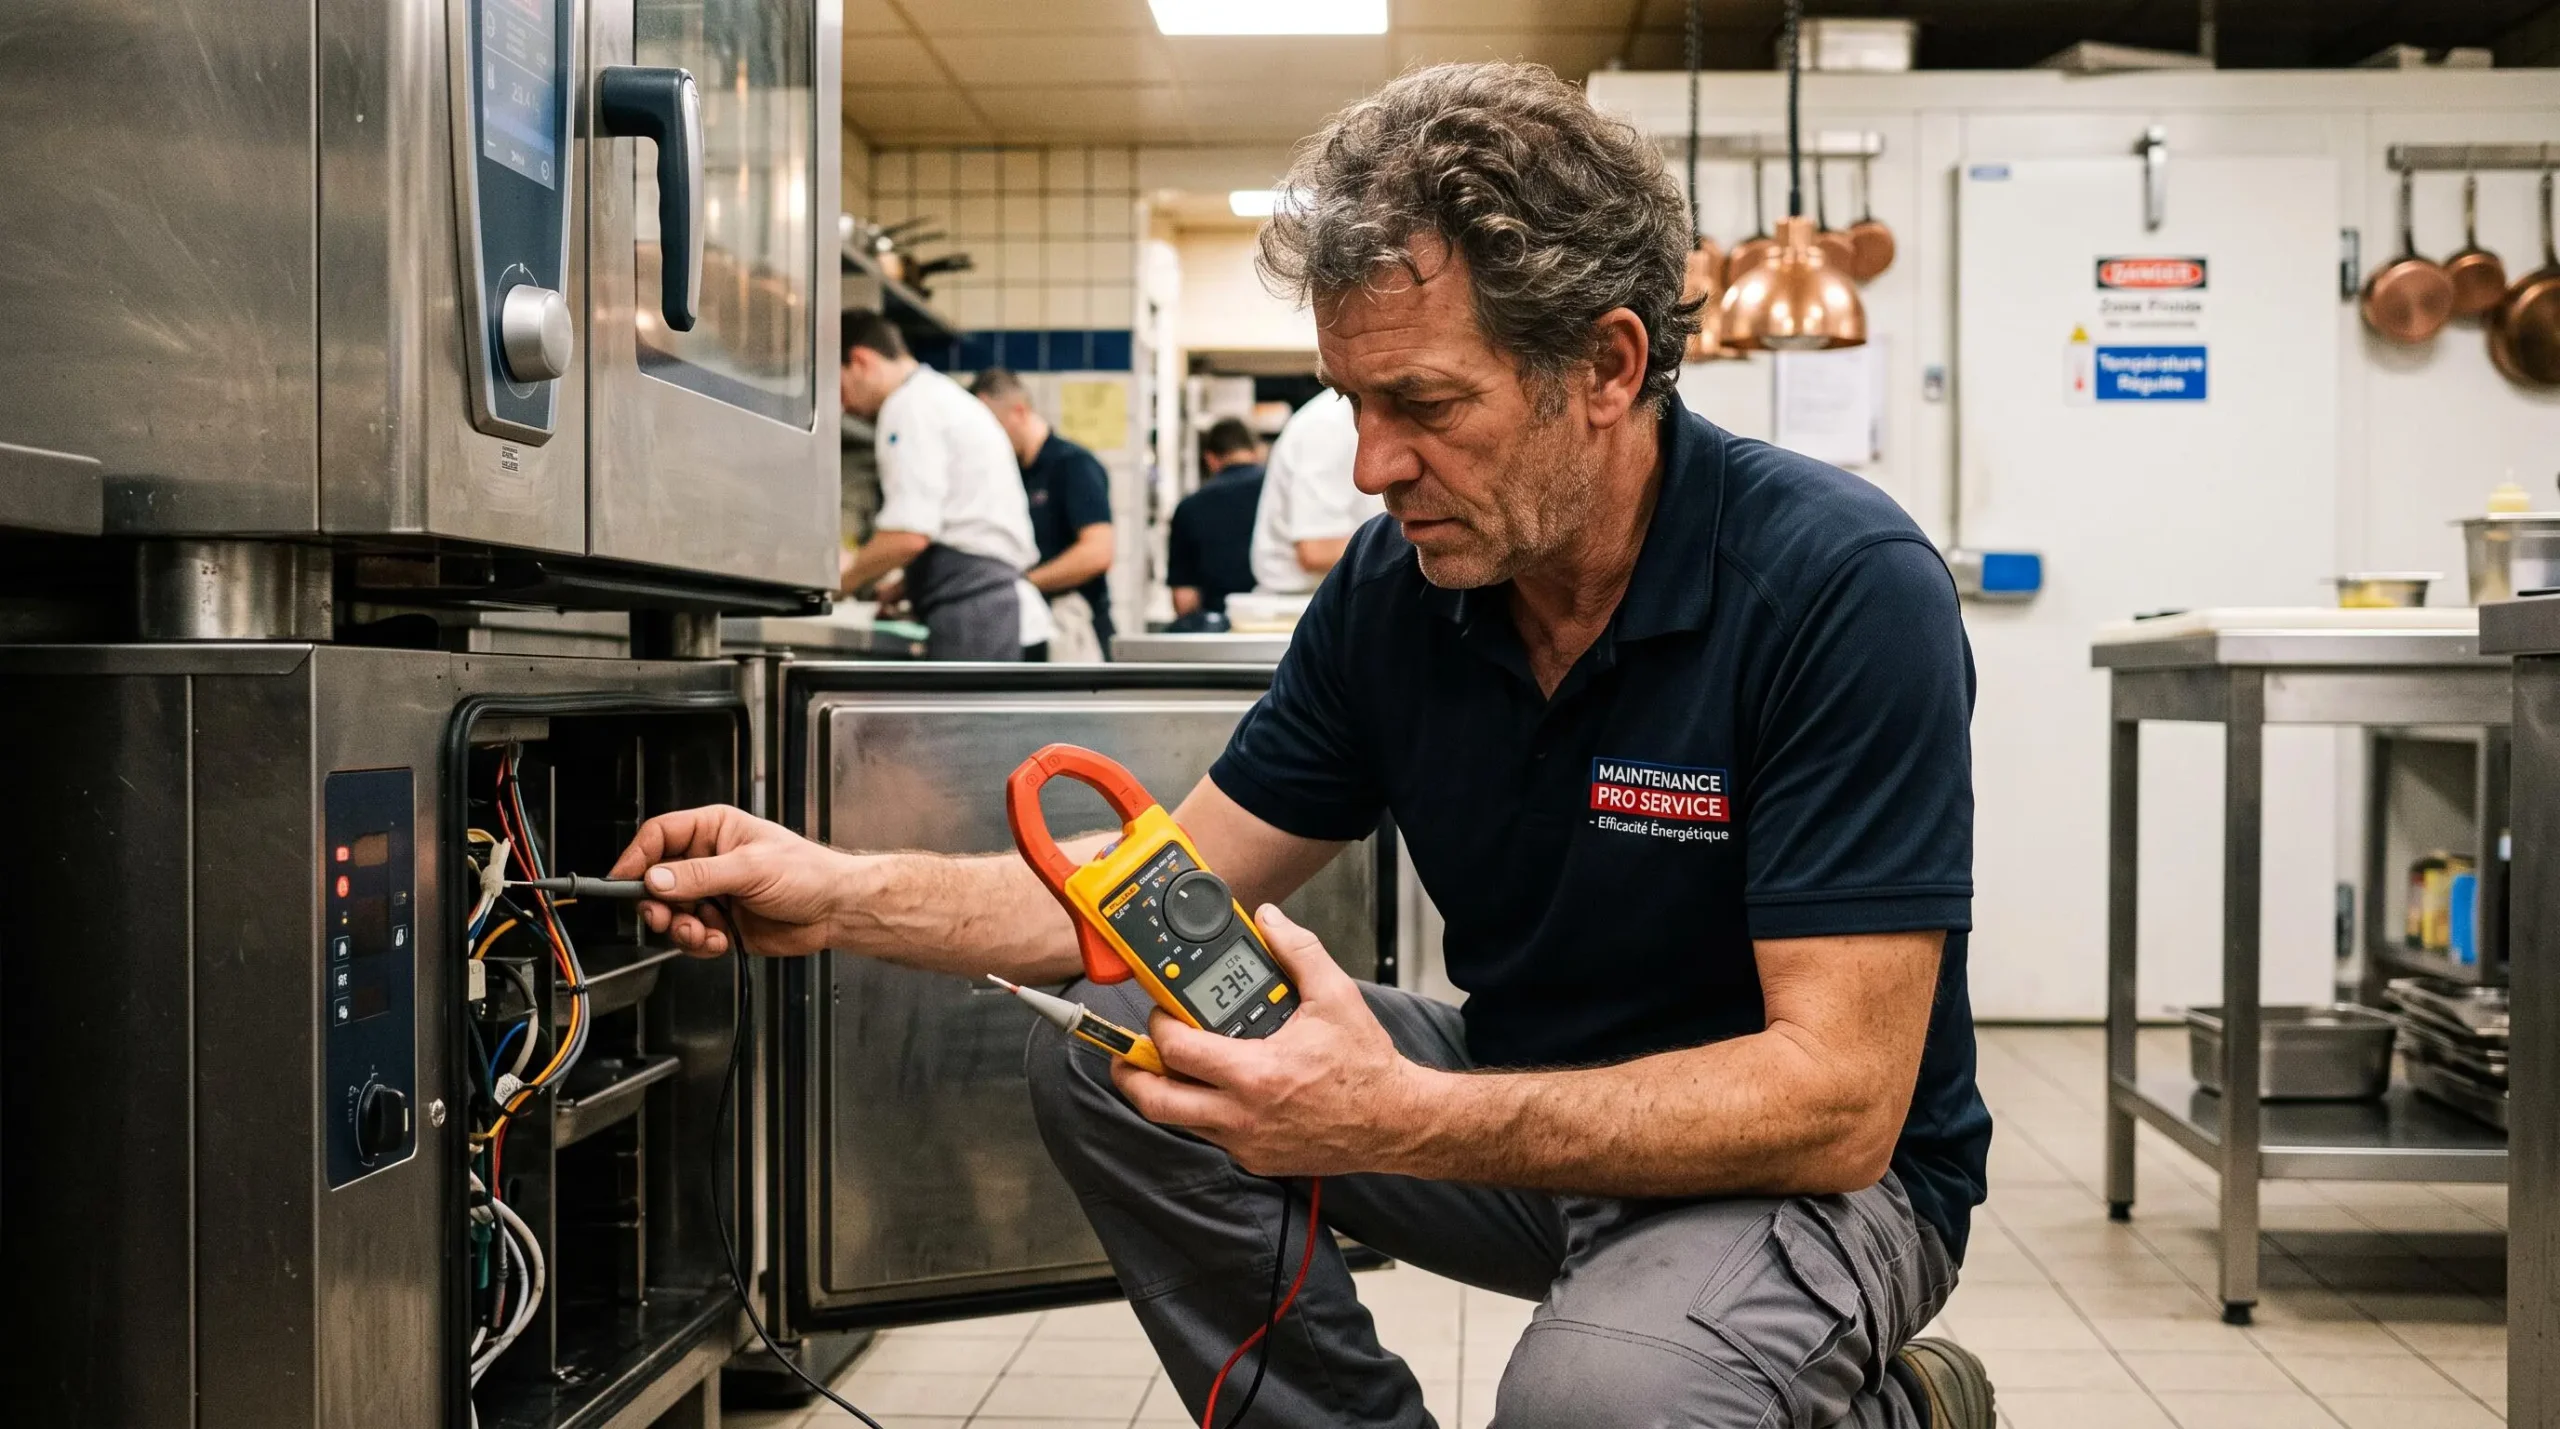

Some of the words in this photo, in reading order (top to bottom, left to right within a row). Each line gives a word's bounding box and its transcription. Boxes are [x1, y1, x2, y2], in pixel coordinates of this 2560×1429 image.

[1599, 764, 1721, 792] MAINTENANCE
[1597, 786, 1636, 809] PRO
[1640, 794, 1722, 817] SERVICE
[1598, 816, 1648, 835] Efficacité
[1651, 820, 1729, 843] Énergétique
[1209, 964, 1254, 1010] 23.4
